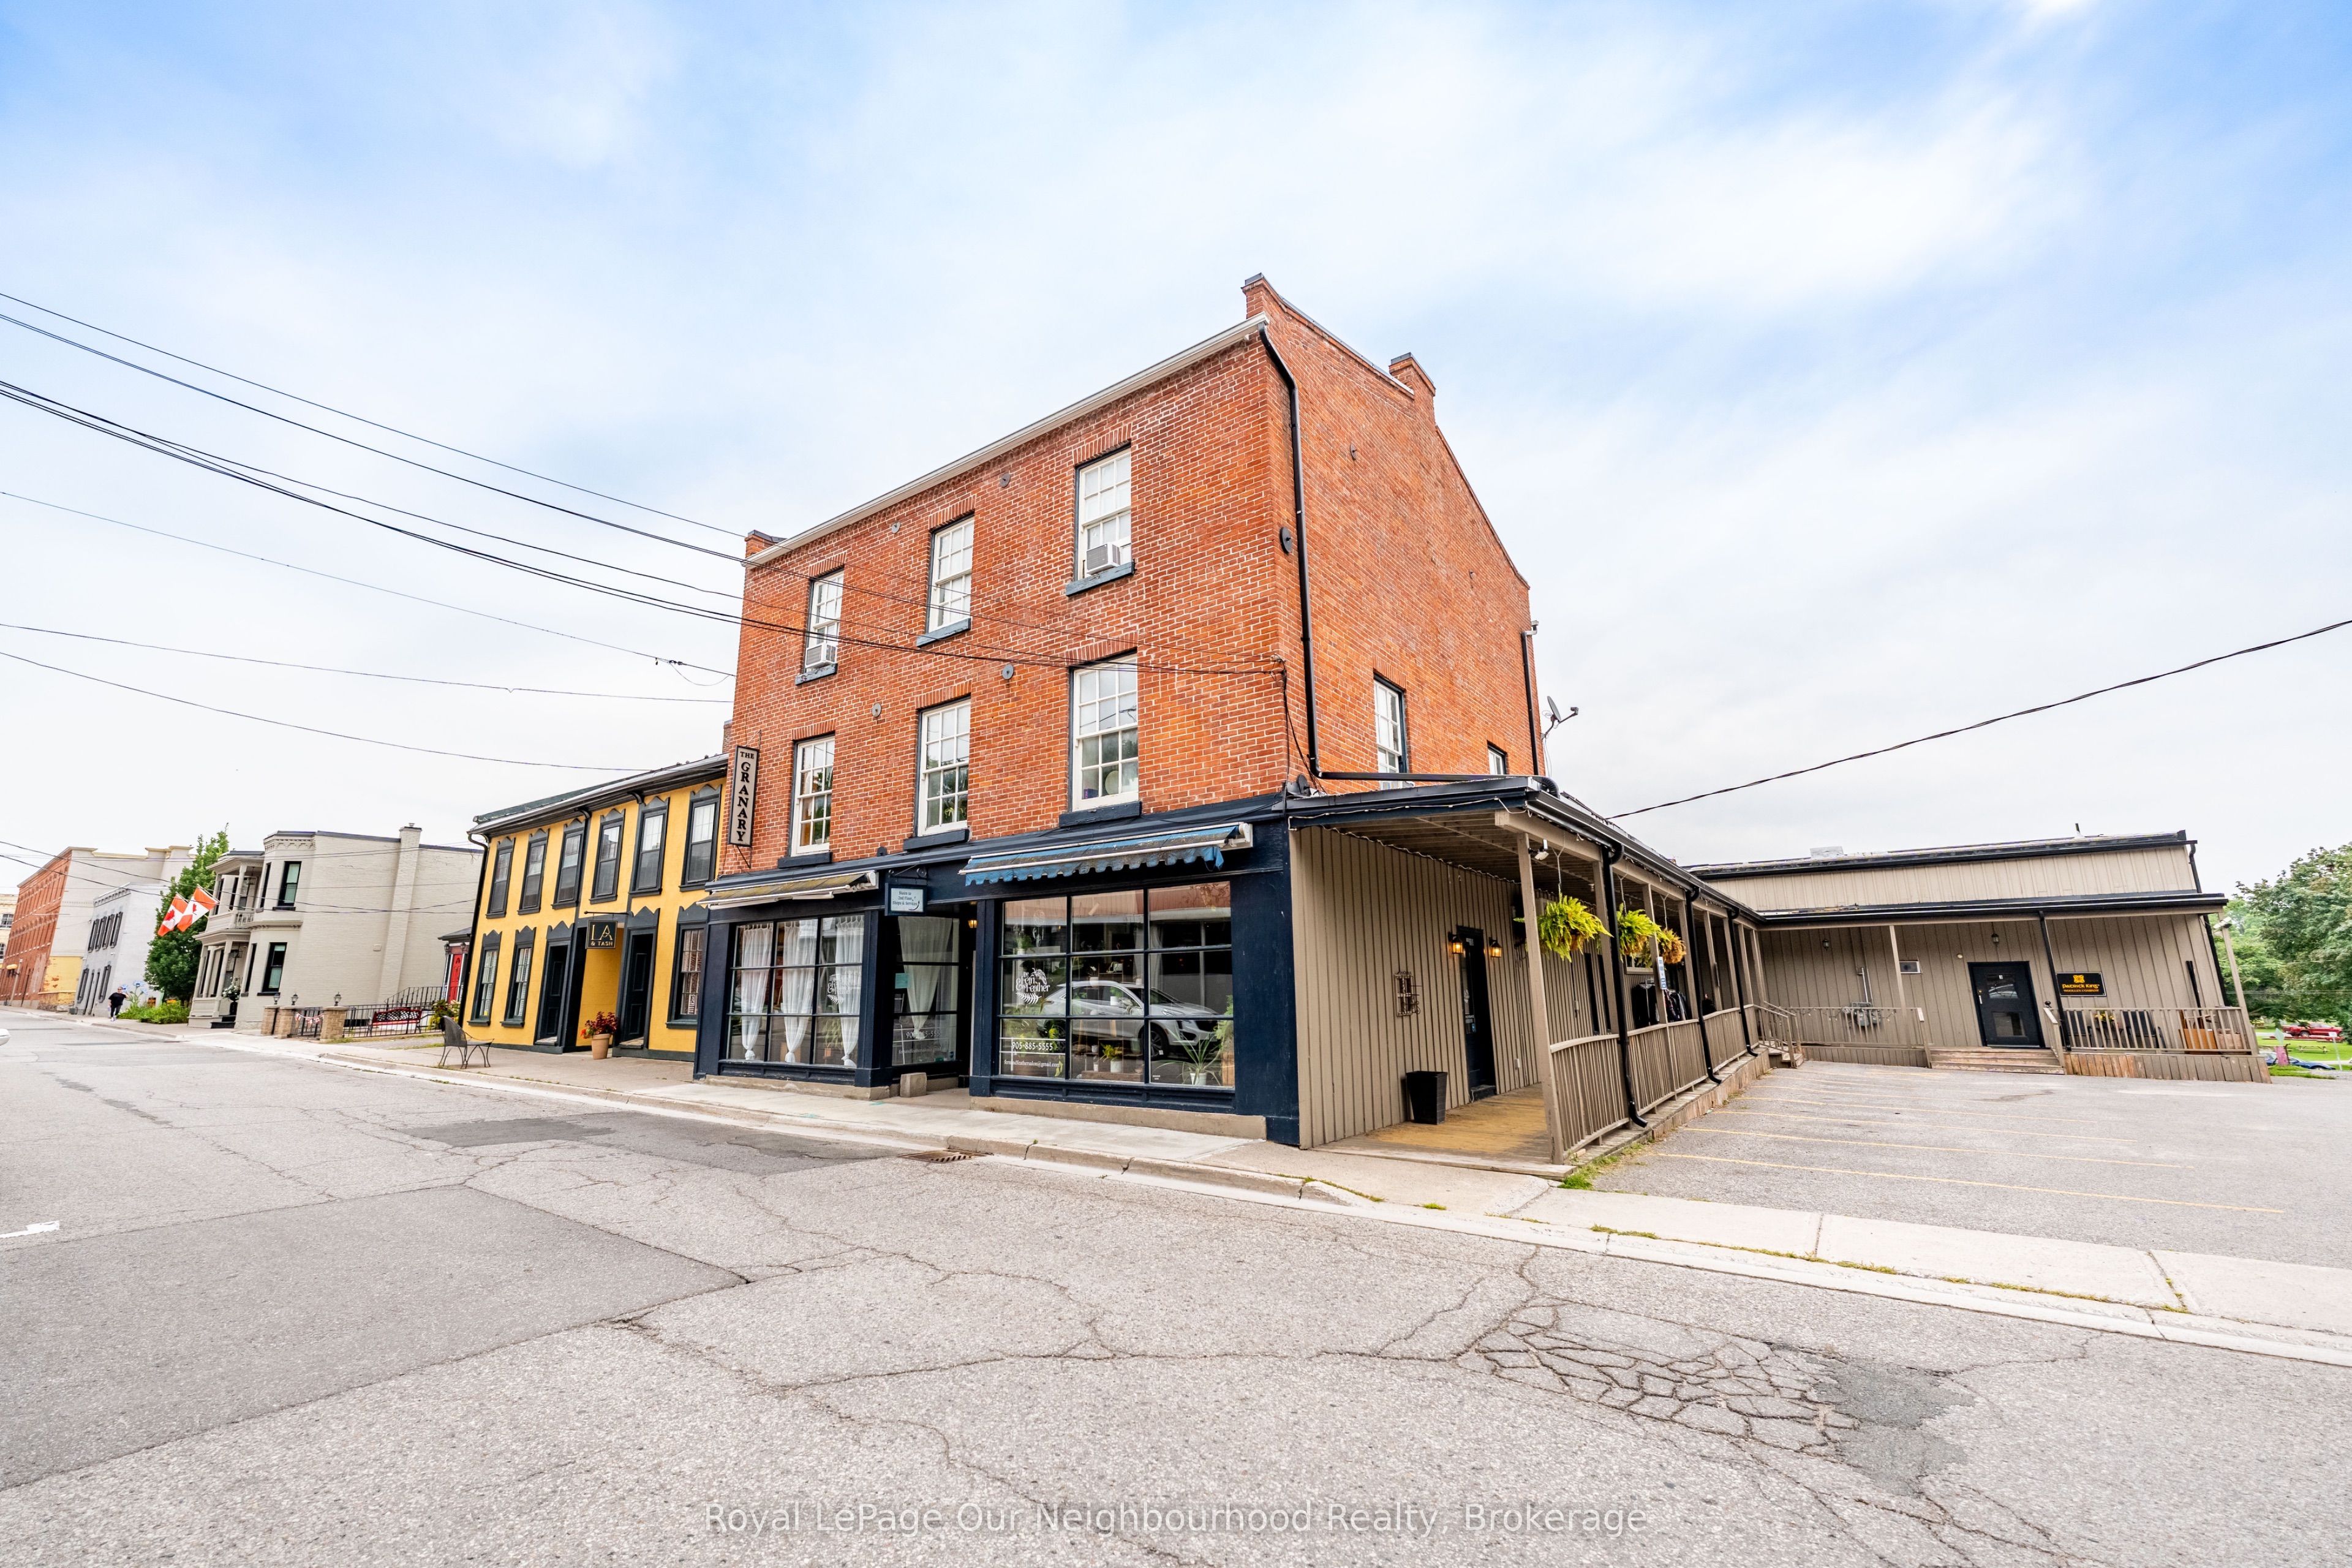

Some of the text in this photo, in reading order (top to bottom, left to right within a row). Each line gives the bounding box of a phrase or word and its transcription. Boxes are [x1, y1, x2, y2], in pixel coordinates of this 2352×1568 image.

[737, 761, 751, 842] GRANARY
[1025, 981, 1050, 992] Feather
[1012, 1042, 1053, 1050] 905-885-5555
